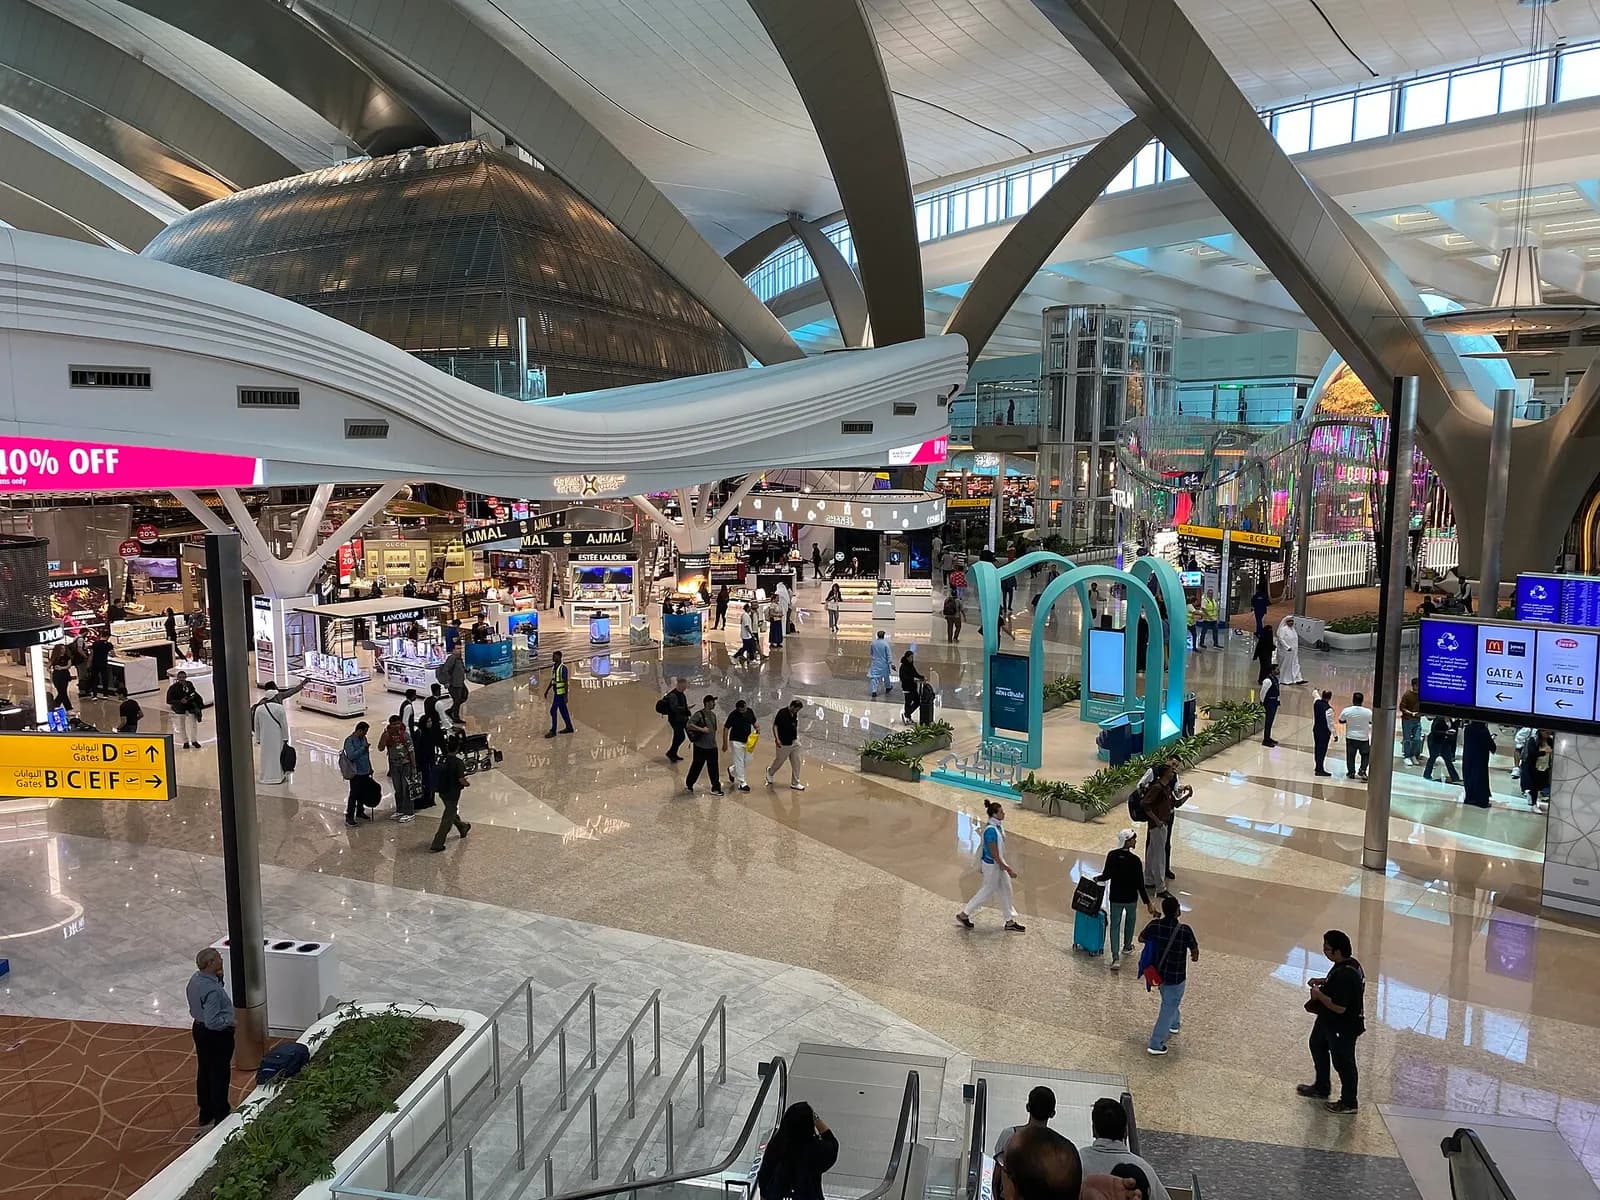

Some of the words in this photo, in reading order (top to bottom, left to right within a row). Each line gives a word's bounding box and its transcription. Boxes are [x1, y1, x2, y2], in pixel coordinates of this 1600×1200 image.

[68, 448, 120, 475] OFF
[534, 517, 553, 532] AJMAL
[465, 526, 507, 546] AJMAL
[520, 535, 549, 546] MAL
[586, 533, 628, 545] AJMAL
[38, 627, 64, 643] DIOR
[1486, 667, 1512, 679] GATE
[1515, 670, 1524, 680] A
[1545, 673, 1573, 686] GATE
[1576, 676, 1585, 687] D
[71, 744, 99, 752] البوابات
[73, 753, 100, 762] Gates
[102, 743, 118, 762] D
[14, 770, 42, 779] البوابات
[16, 779, 42, 788] Gates
[44, 770, 58, 788] B
[67, 770, 82, 789] C
[89, 771, 102, 789] E
[109, 771, 120, 790] F
